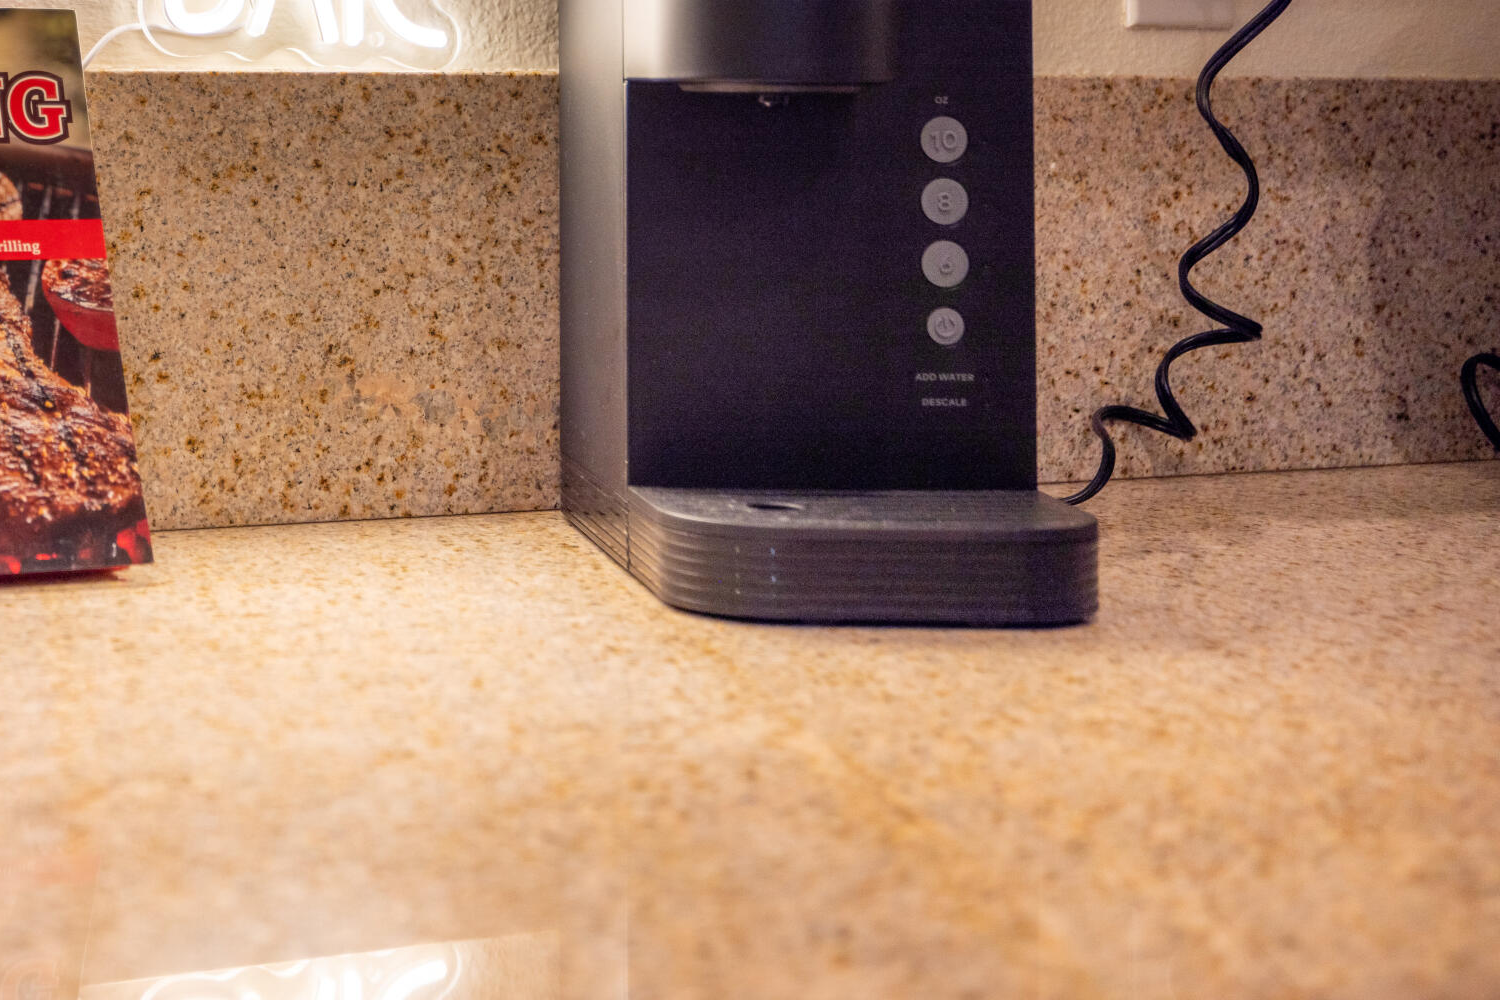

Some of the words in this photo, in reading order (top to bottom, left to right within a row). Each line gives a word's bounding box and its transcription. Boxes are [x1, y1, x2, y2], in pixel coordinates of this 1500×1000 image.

[930, 130, 957, 151] 10
[937, 192, 953, 212] 8
[915, 373, 936, 381] ADD
[938, 373, 975, 382] WATER
[921, 398, 967, 407] DESCALE
